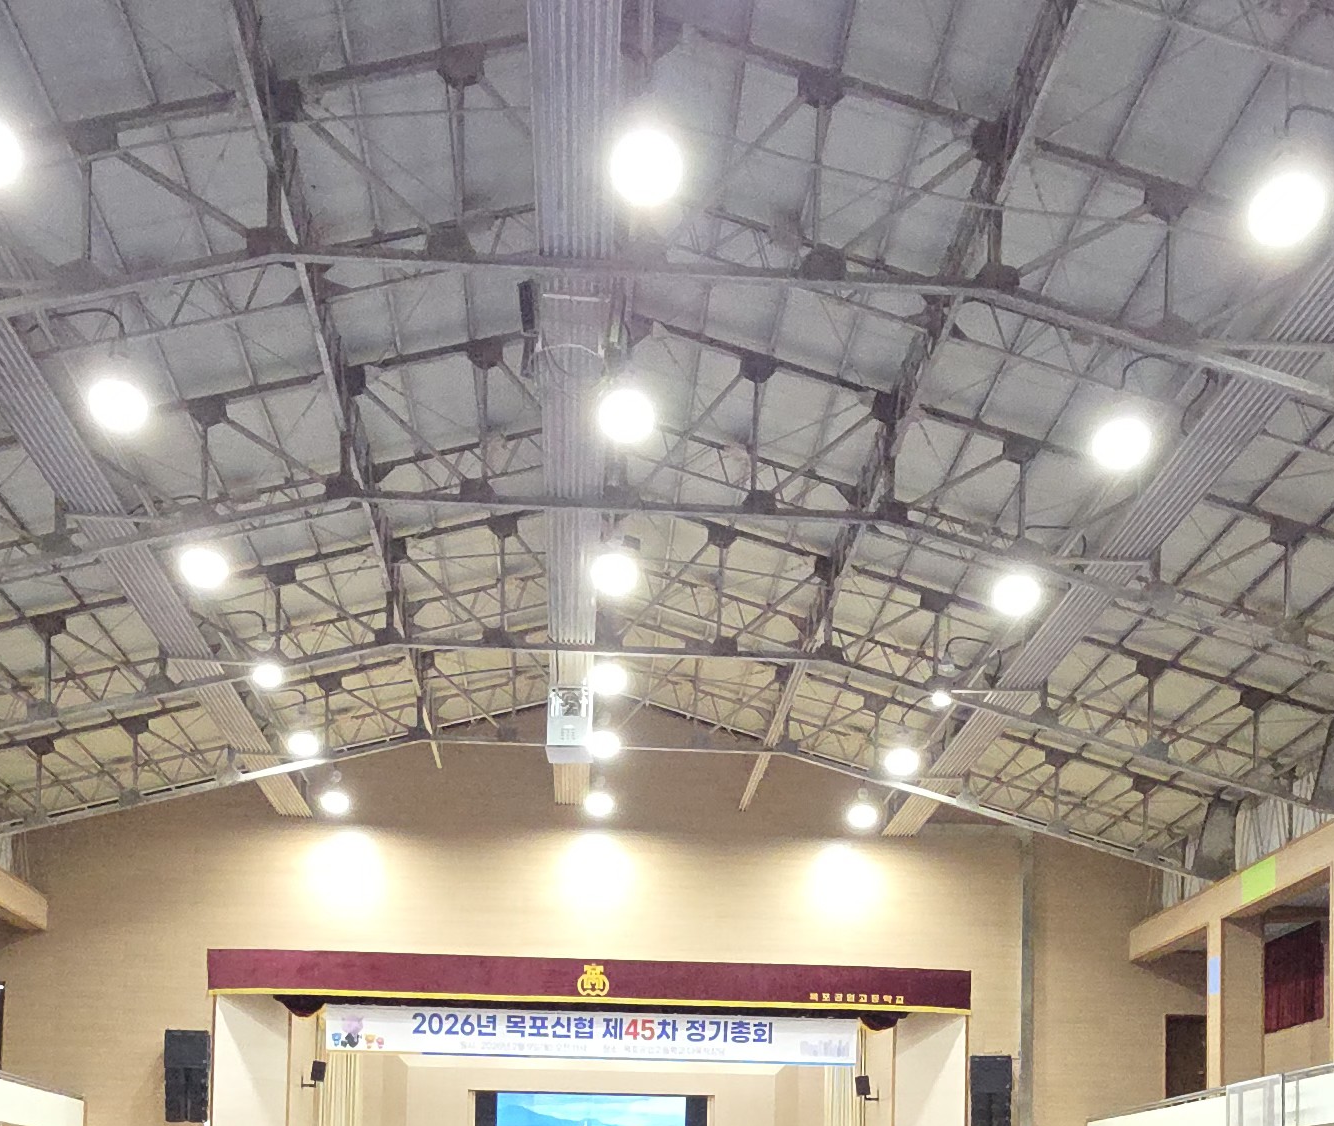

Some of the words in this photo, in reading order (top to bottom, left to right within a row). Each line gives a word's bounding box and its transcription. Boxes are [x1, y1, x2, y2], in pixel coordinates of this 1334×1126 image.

[411, 1012, 497, 1037] 2026년
[505, 1015, 594, 1039] 목포신협
[602, 1017, 678, 1041] 제45차
[686, 1019, 773, 1044] 정기총회
